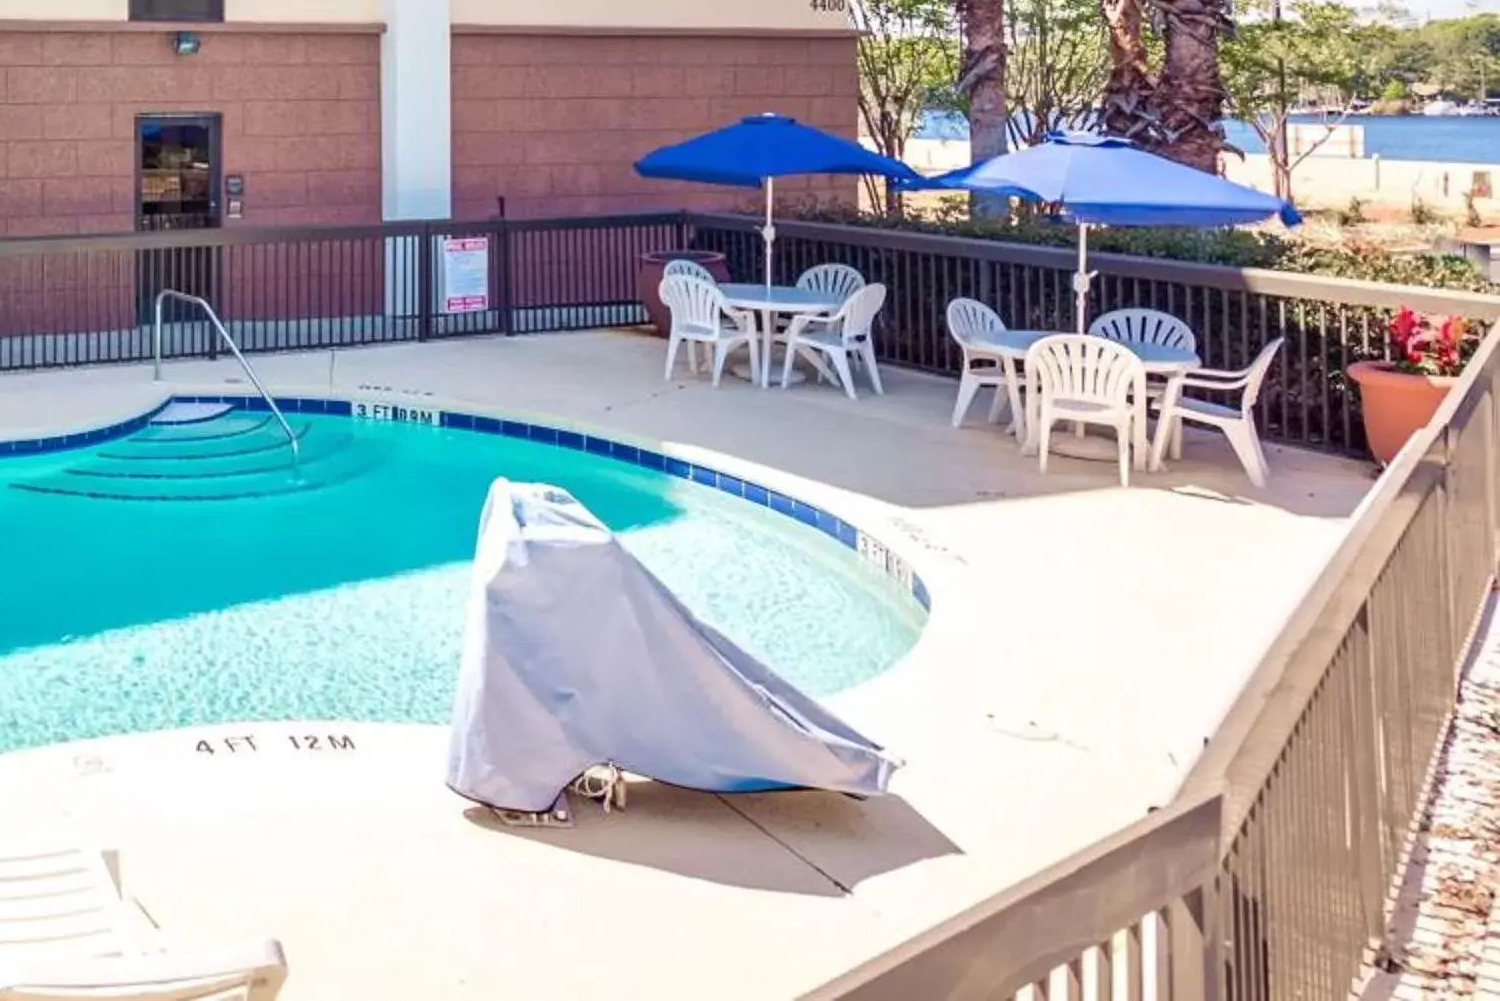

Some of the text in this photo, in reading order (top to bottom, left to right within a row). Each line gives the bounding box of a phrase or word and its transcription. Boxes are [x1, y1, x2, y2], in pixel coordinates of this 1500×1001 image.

[373, 404, 390, 421] FT
[196, 739, 215, 756] 4
[224, 735, 257, 753] FT
